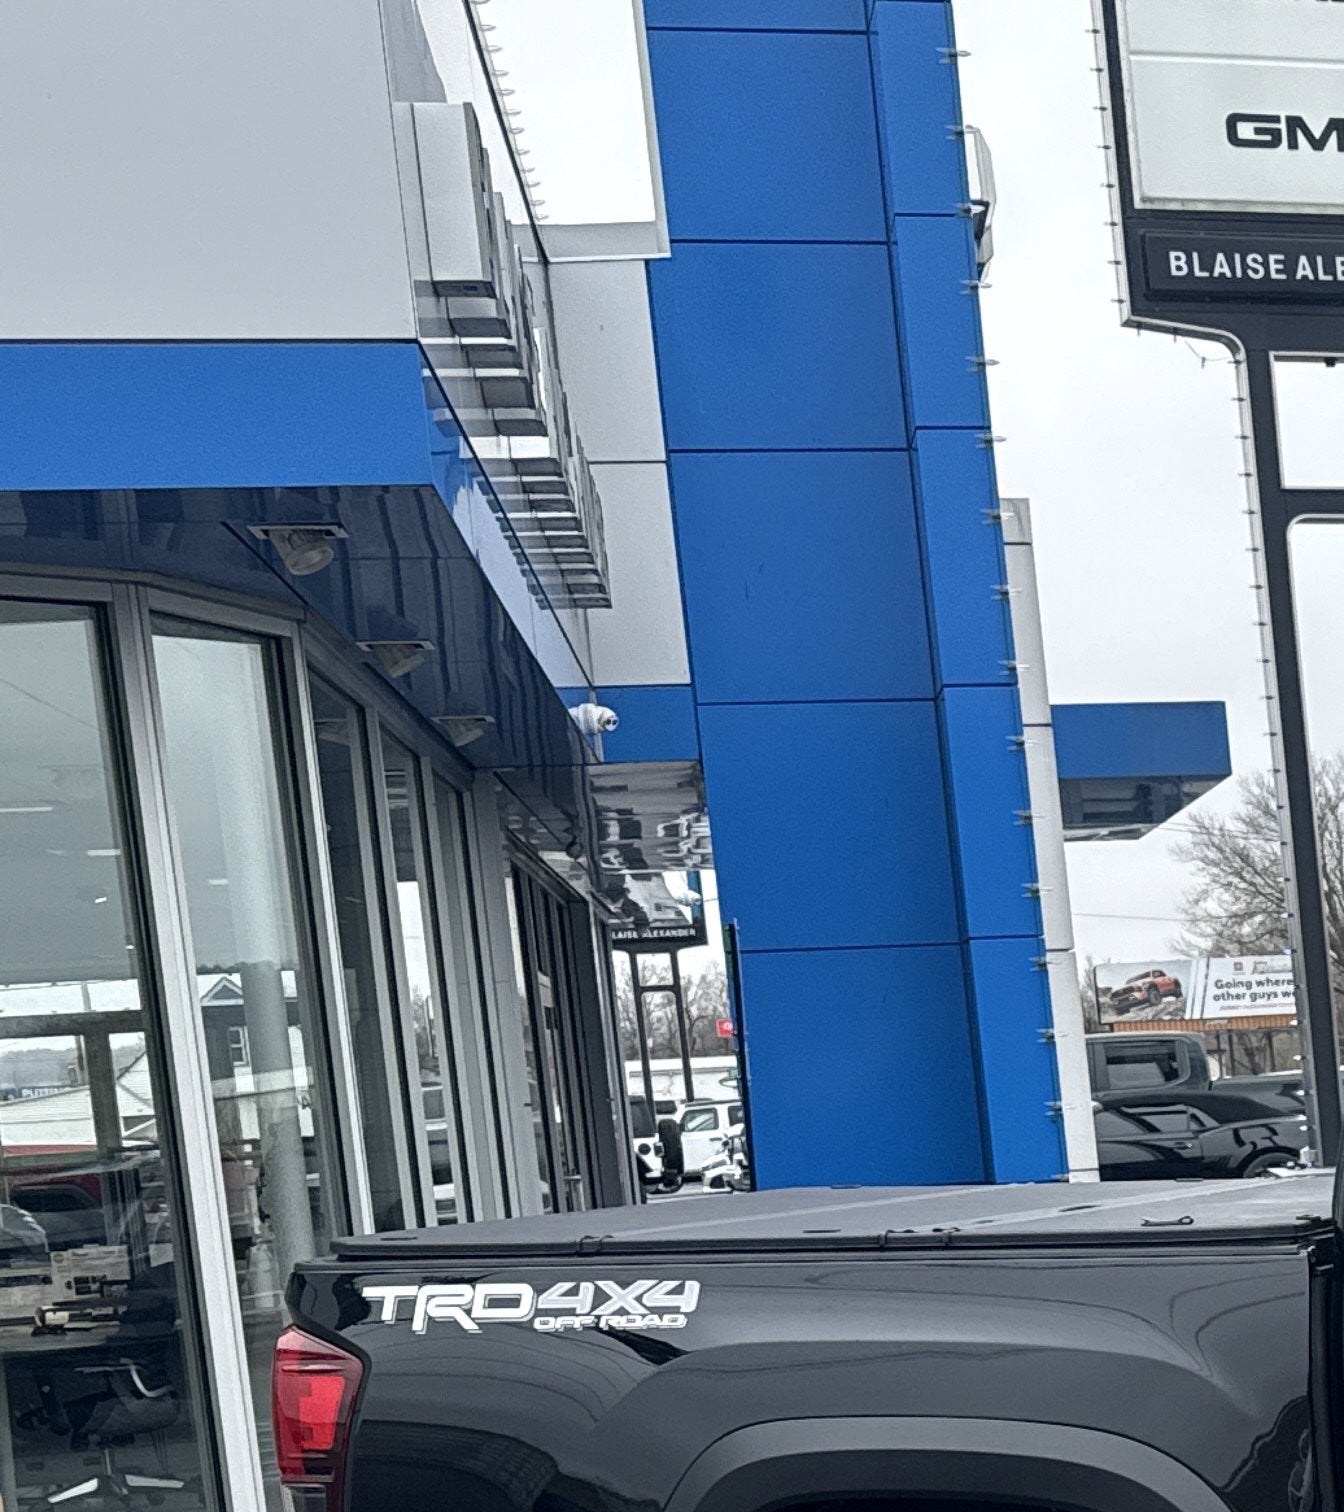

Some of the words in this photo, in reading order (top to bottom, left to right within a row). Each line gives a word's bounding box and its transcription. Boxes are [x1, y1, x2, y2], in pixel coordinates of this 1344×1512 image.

[1168, 251, 1287, 281] BLAISE
[1214, 979, 1253, 990] Going
[1255, 977, 1295, 988] where
[1212, 991, 1247, 1002] other
[1249, 991, 1279, 1002] guys
[361, 1282, 537, 1334] TRD
[533, 1316, 596, 1332] OFF
[597, 1313, 689, 1330] ROAD
